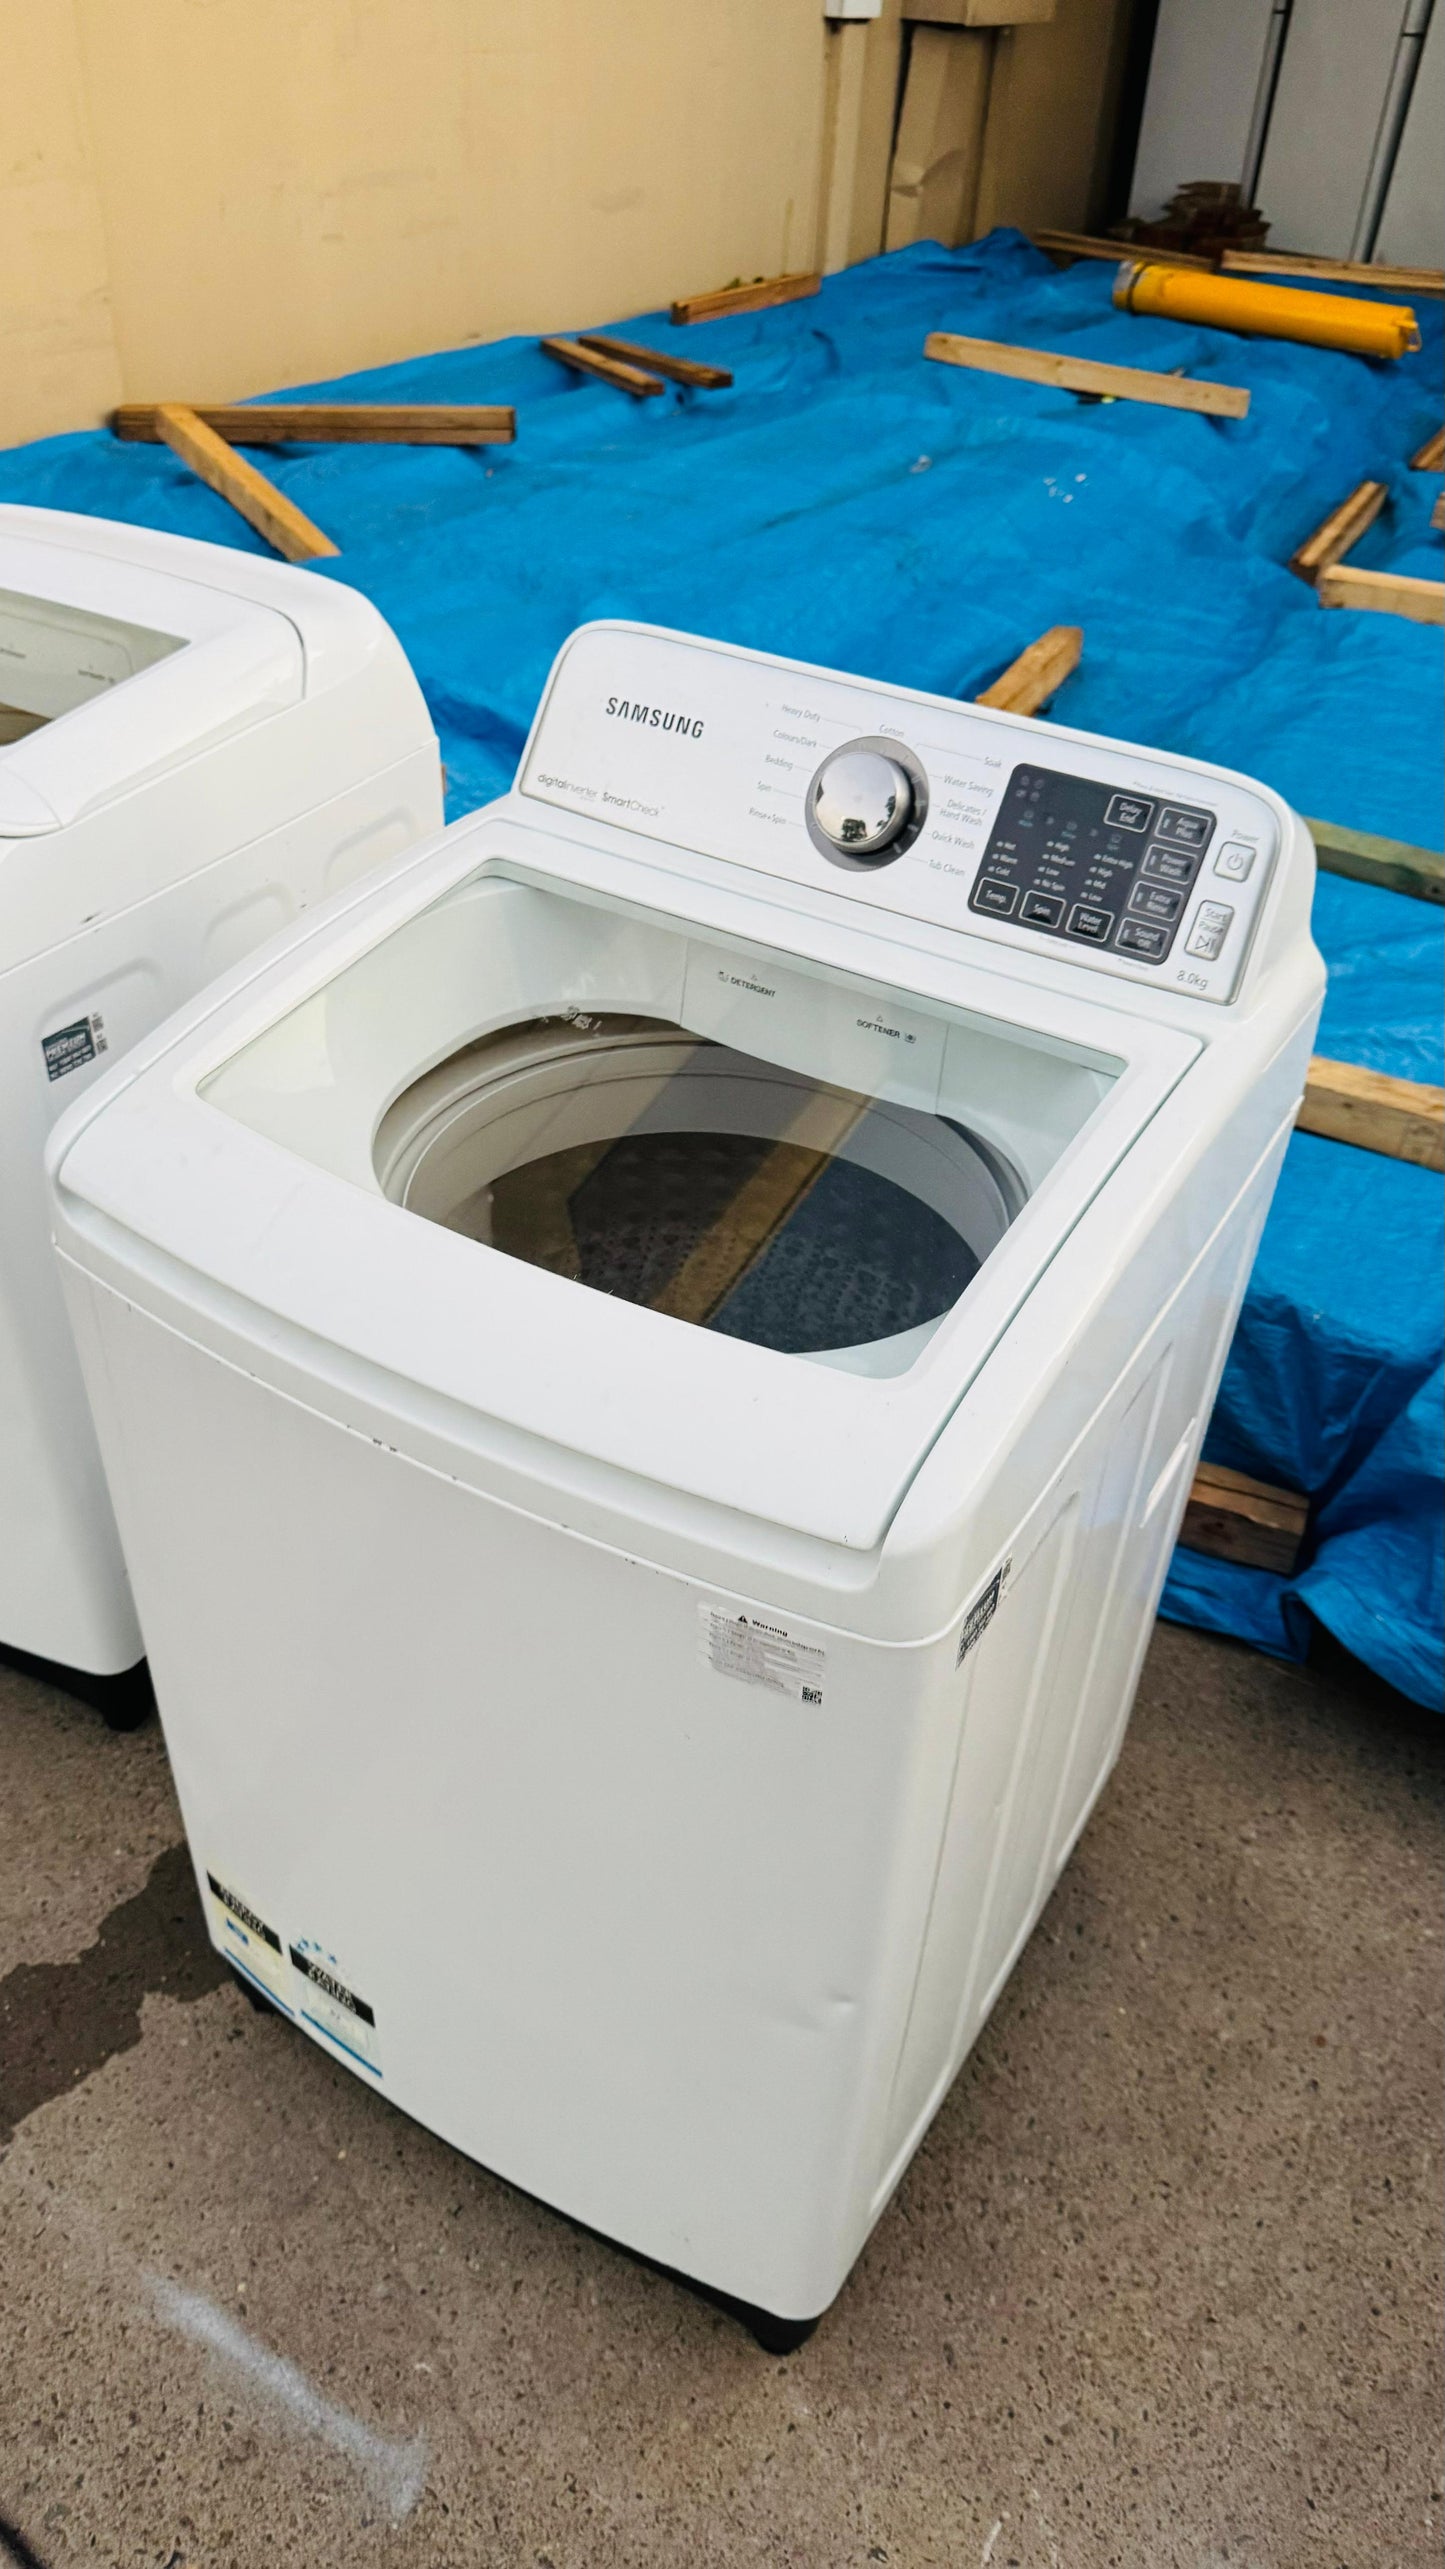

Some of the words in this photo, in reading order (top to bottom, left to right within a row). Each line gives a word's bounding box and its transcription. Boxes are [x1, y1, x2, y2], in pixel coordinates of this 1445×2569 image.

[606, 697, 705, 739] SAMSUNG
[782, 704, 802, 718] Heavy
[803, 709, 821, 722] Duty
[879, 724, 904, 737] Cotton
[765, 754, 793, 771] Bedding
[944, 774, 967, 788] Water
[968, 781, 994, 798] Saving
[947, 799, 980, 816] Delicates
[940, 808, 960, 821] Hand
[962, 814, 982, 826] Wash
[932, 830, 952, 843] Quick
[954, 836, 975, 849] Wash
[1231, 829, 1260, 842] Power
[943, 863, 965, 877] Clean
[1205, 907, 1227, 920] Start
[730, 976, 776, 998] DETERGENT
[1176, 969, 1209, 991] 8.0kg
[856, 1017, 900, 1039] SOFTENER
[752, 1619, 788, 1638] Warning
